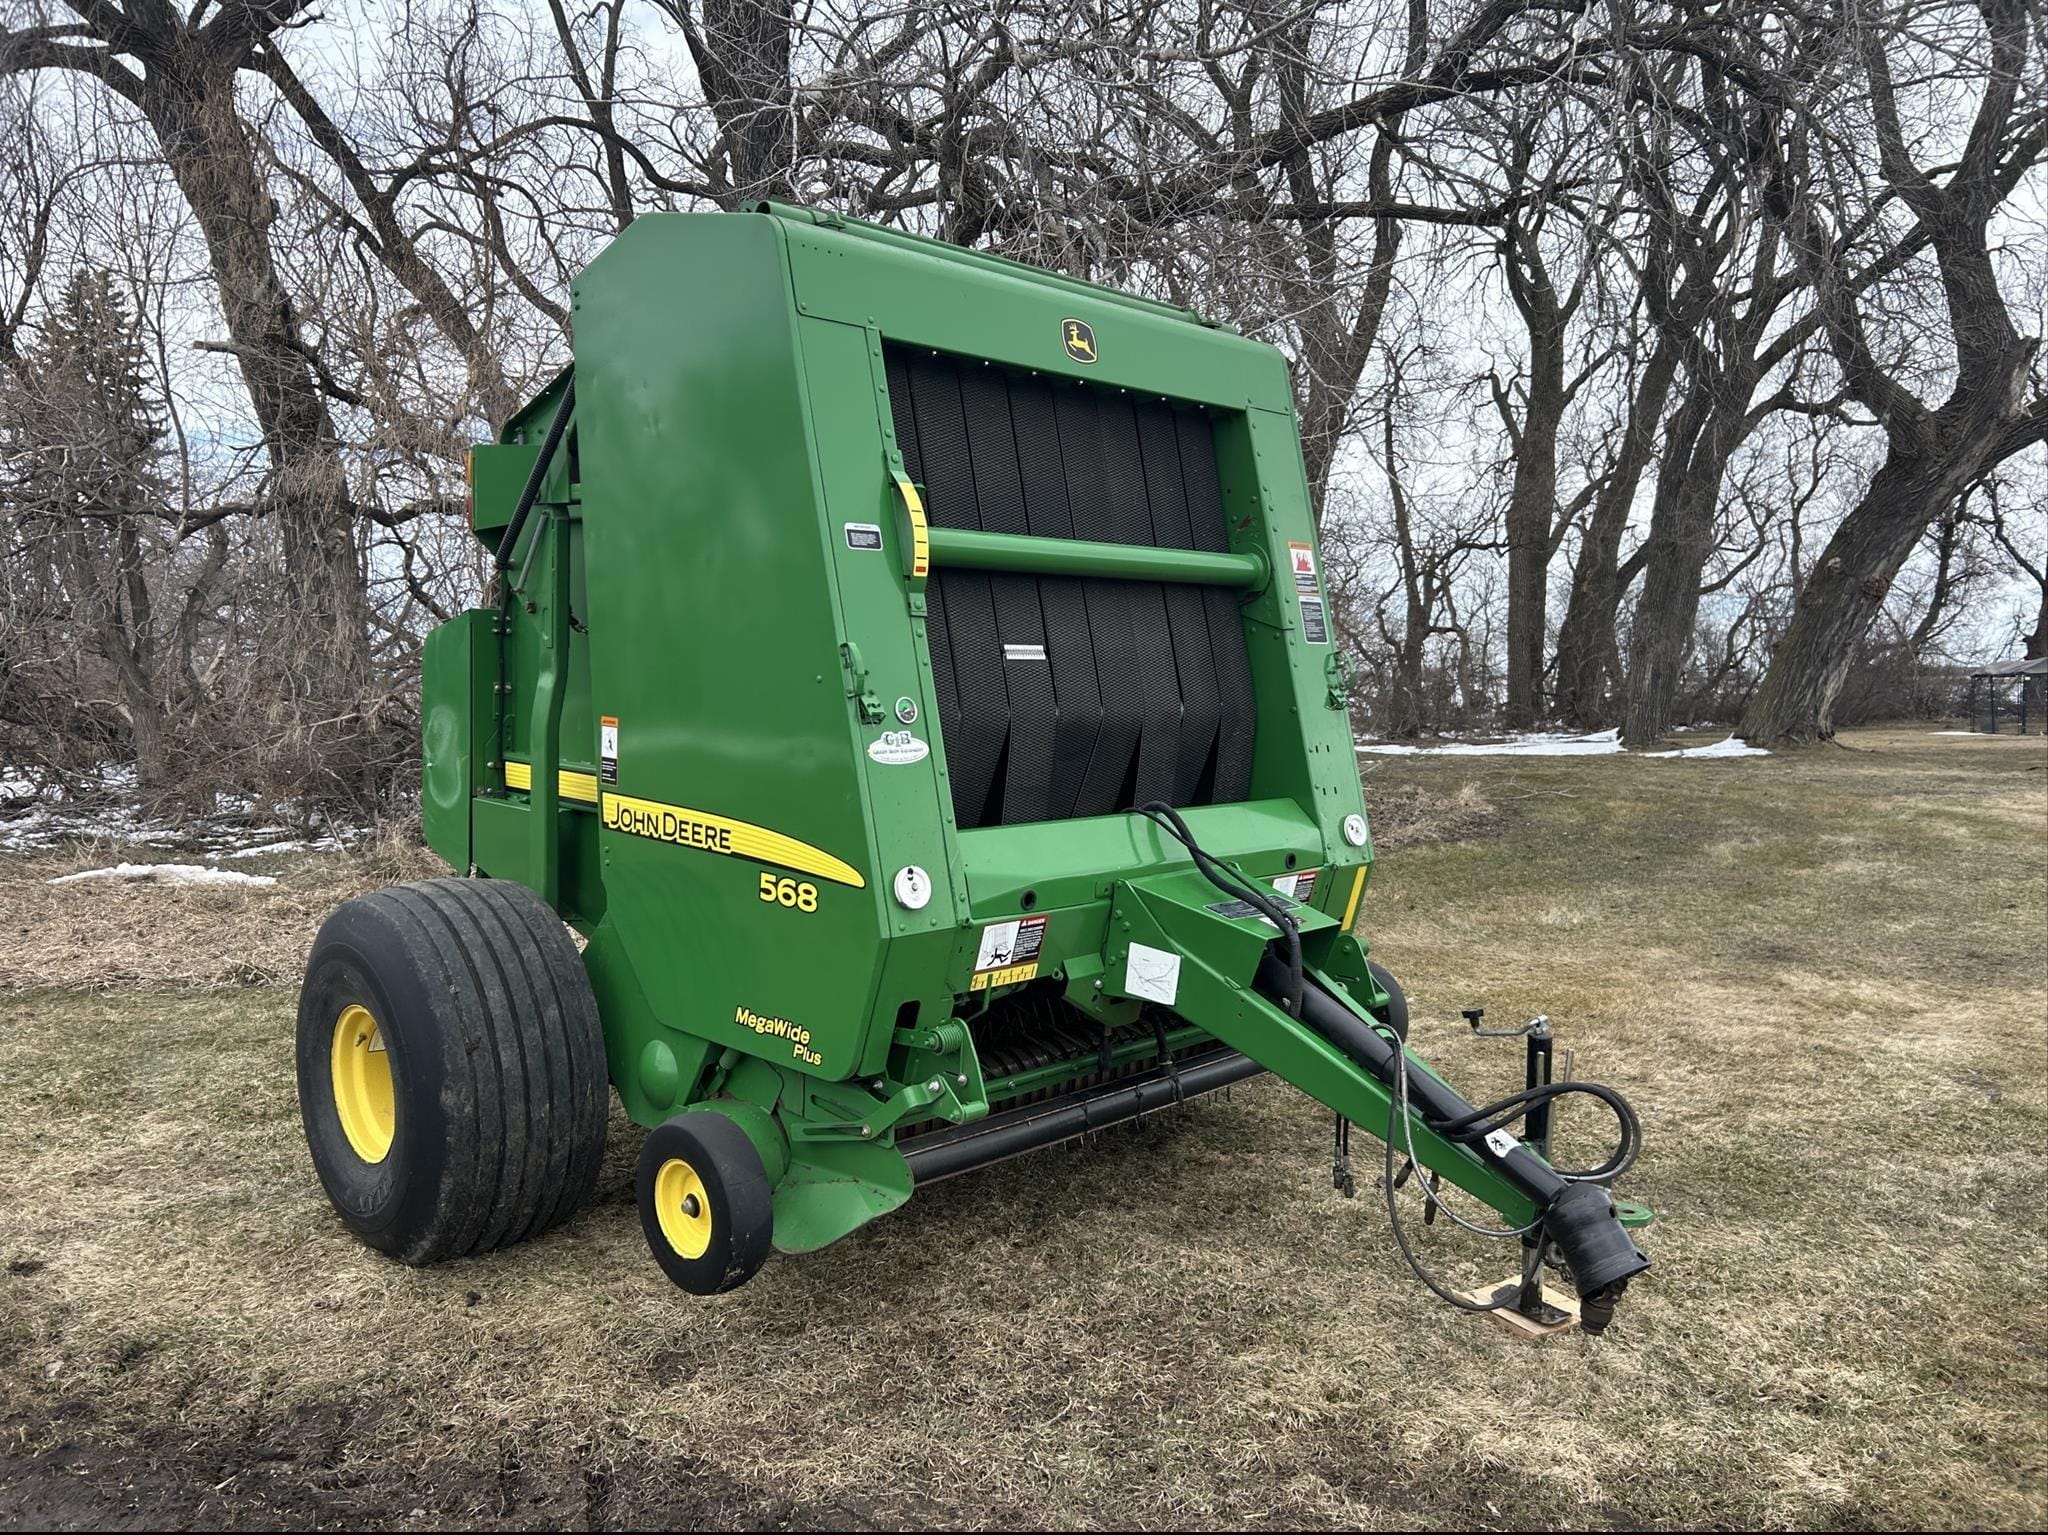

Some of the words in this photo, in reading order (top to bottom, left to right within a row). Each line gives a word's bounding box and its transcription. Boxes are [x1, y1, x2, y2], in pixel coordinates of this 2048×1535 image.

[610, 803, 659, 837] JOHN
[663, 812, 732, 851] DEERE
[759, 871, 819, 914] 568
[735, 1006, 811, 1045] MegaWide
[793, 1043, 823, 1066] Plus
